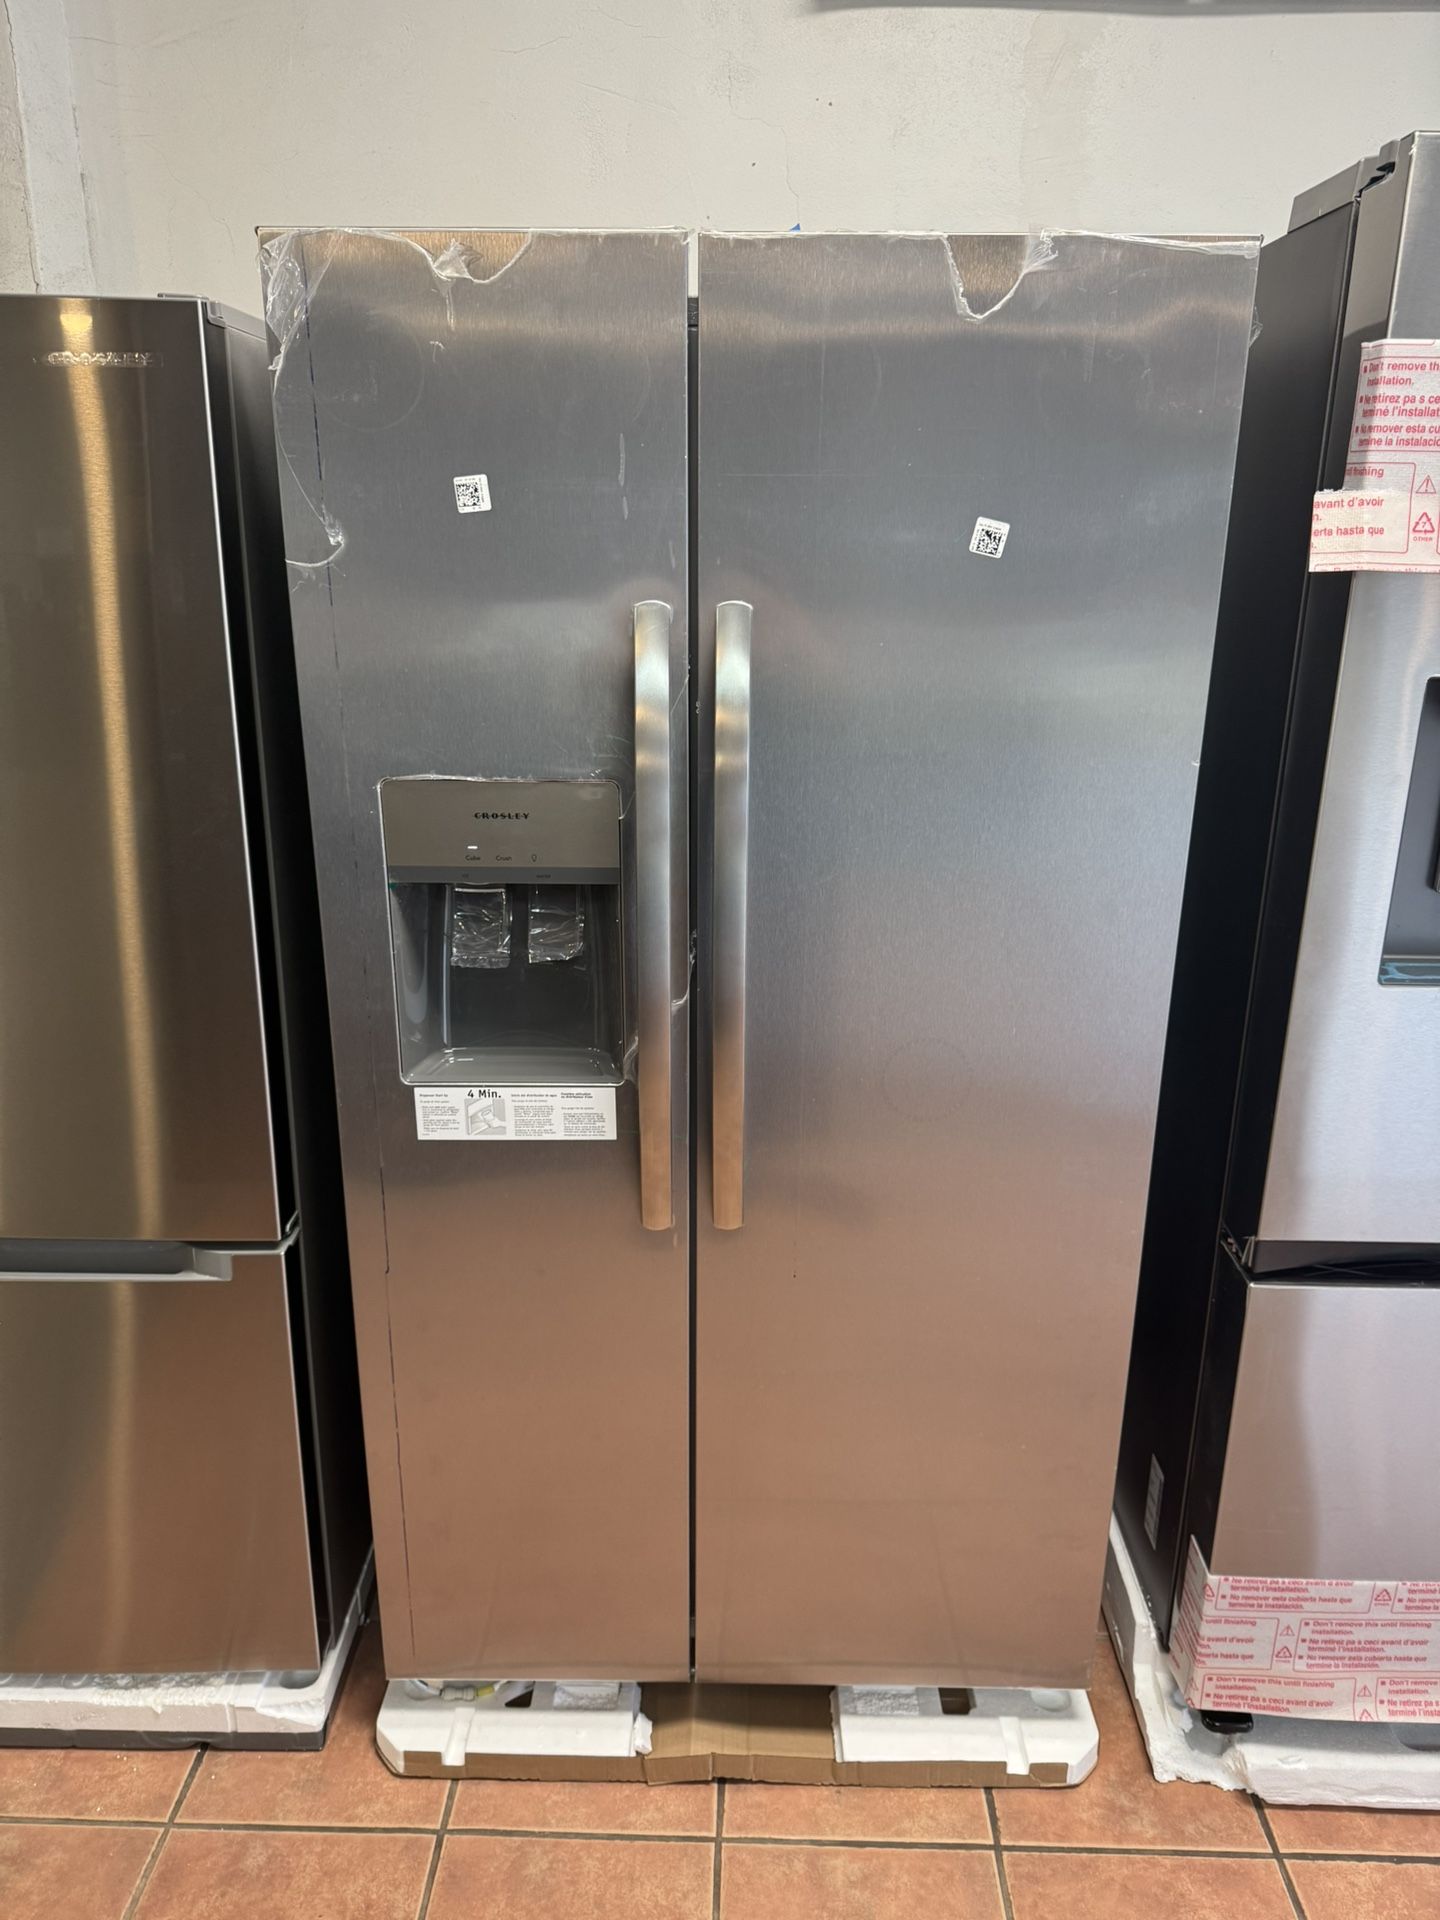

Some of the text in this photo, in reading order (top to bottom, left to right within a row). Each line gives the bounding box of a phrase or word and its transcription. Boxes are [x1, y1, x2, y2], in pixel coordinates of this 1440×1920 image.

[1388, 362, 1426, 370] remove
[1403, 395, 1416, 406] pa
[1418, 395, 1425, 404] s
[1406, 424, 1426, 434] esta
[1385, 436, 1393, 446] la
[1314, 497, 1384, 509] avant d'avoir
[1336, 526, 1364, 536] hasta
[1368, 526, 1384, 536] que
[474, 812, 529, 820] CROSLEY
[467, 1089, 474, 1098] 4
[478, 1089, 501, 1098] Min.
